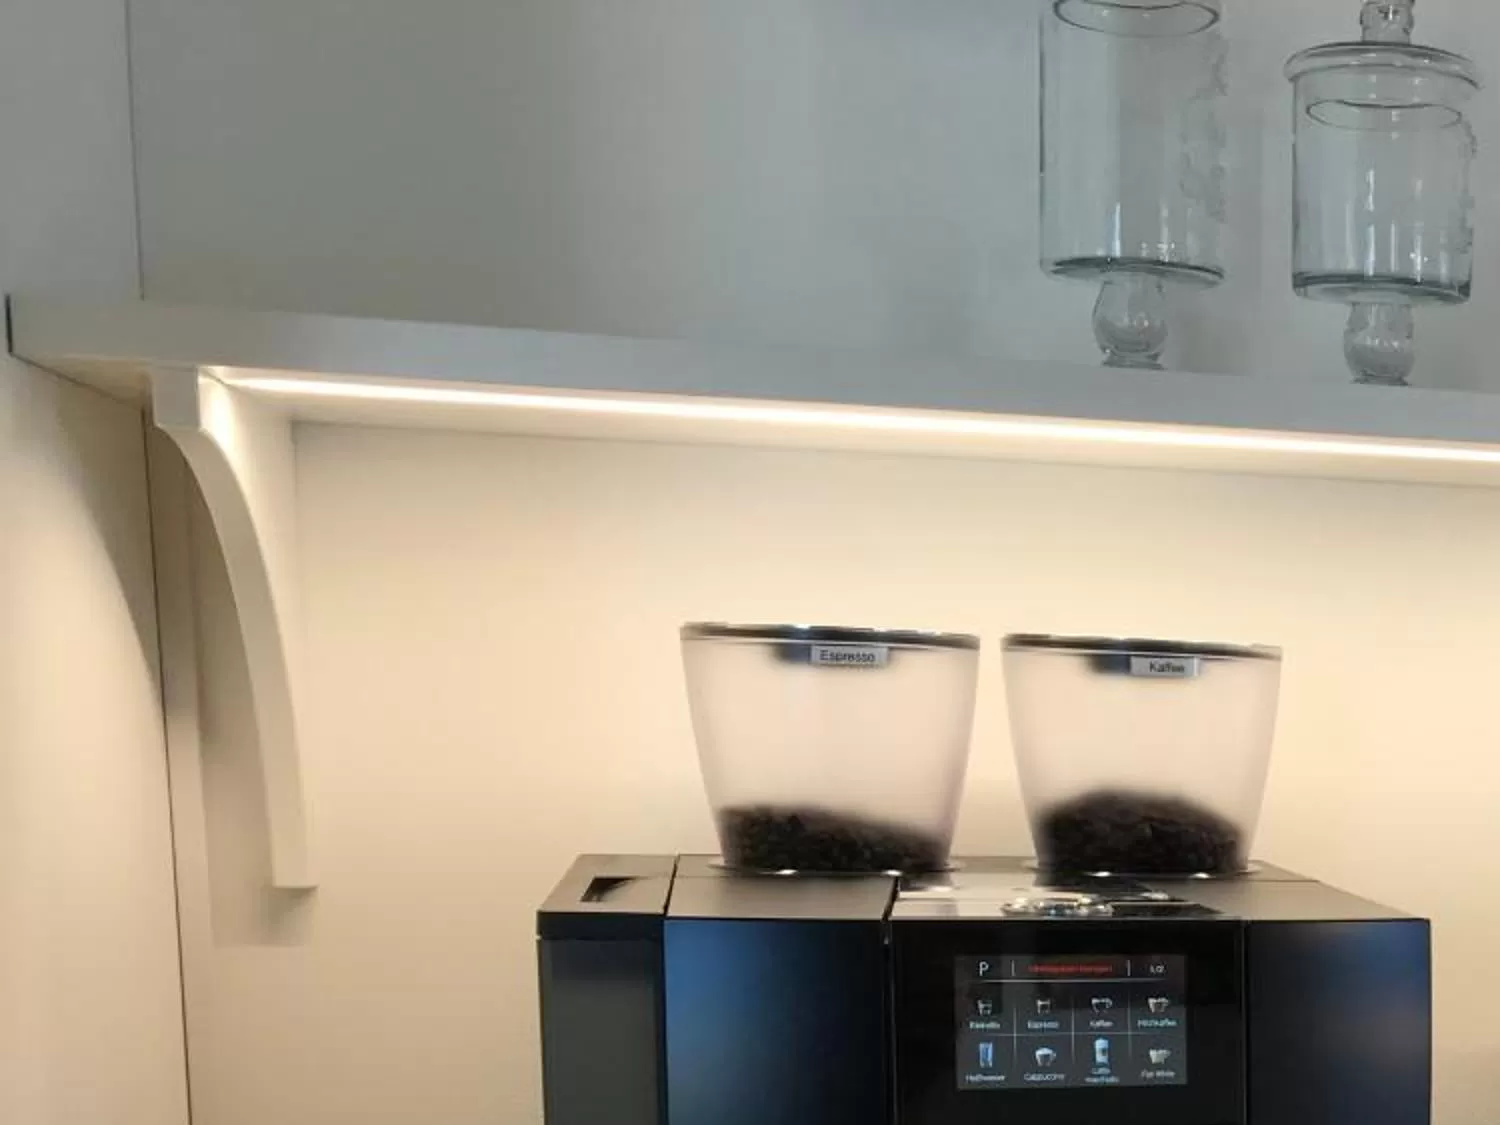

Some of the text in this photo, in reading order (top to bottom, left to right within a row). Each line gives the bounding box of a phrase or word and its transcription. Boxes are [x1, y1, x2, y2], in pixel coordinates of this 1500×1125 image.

[820, 649, 876, 663] Espresso
[1149, 661, 1186, 673] Kaffee
[979, 961, 990, 977] P
